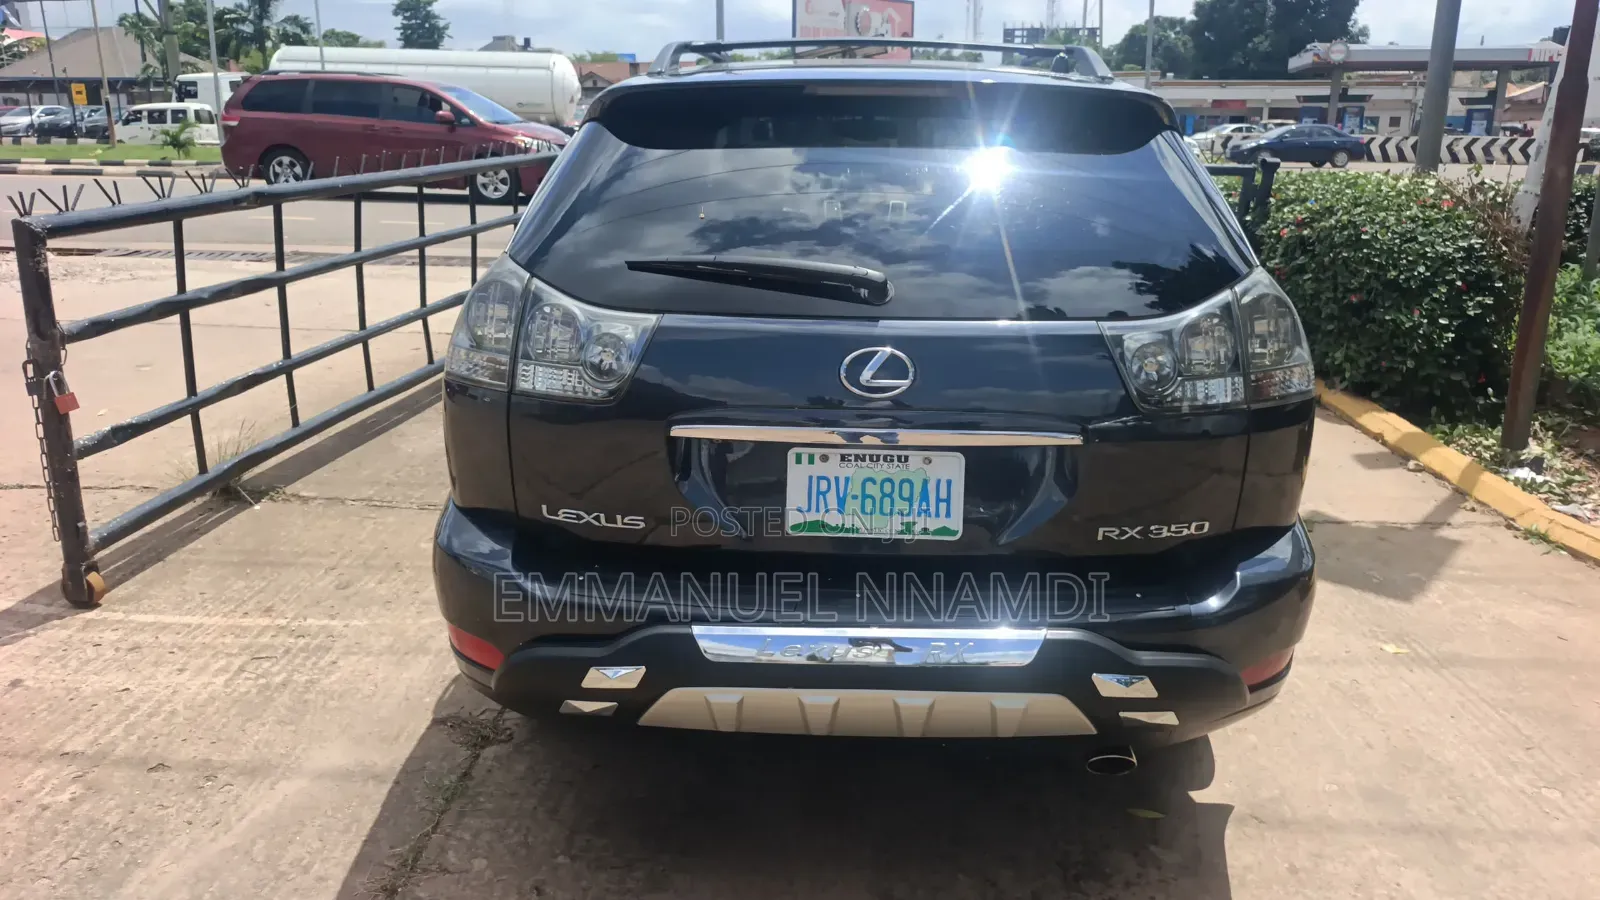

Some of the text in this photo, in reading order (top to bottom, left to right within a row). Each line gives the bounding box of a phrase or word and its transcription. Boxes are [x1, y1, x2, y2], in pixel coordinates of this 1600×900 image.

[839, 453, 910, 464] ENUGU
[797, 475, 952, 518] JRV-689AH
[541, 504, 646, 529] LEXUS
[1097, 521, 1210, 540] RX 350
[924, 641, 975, 665] RX
